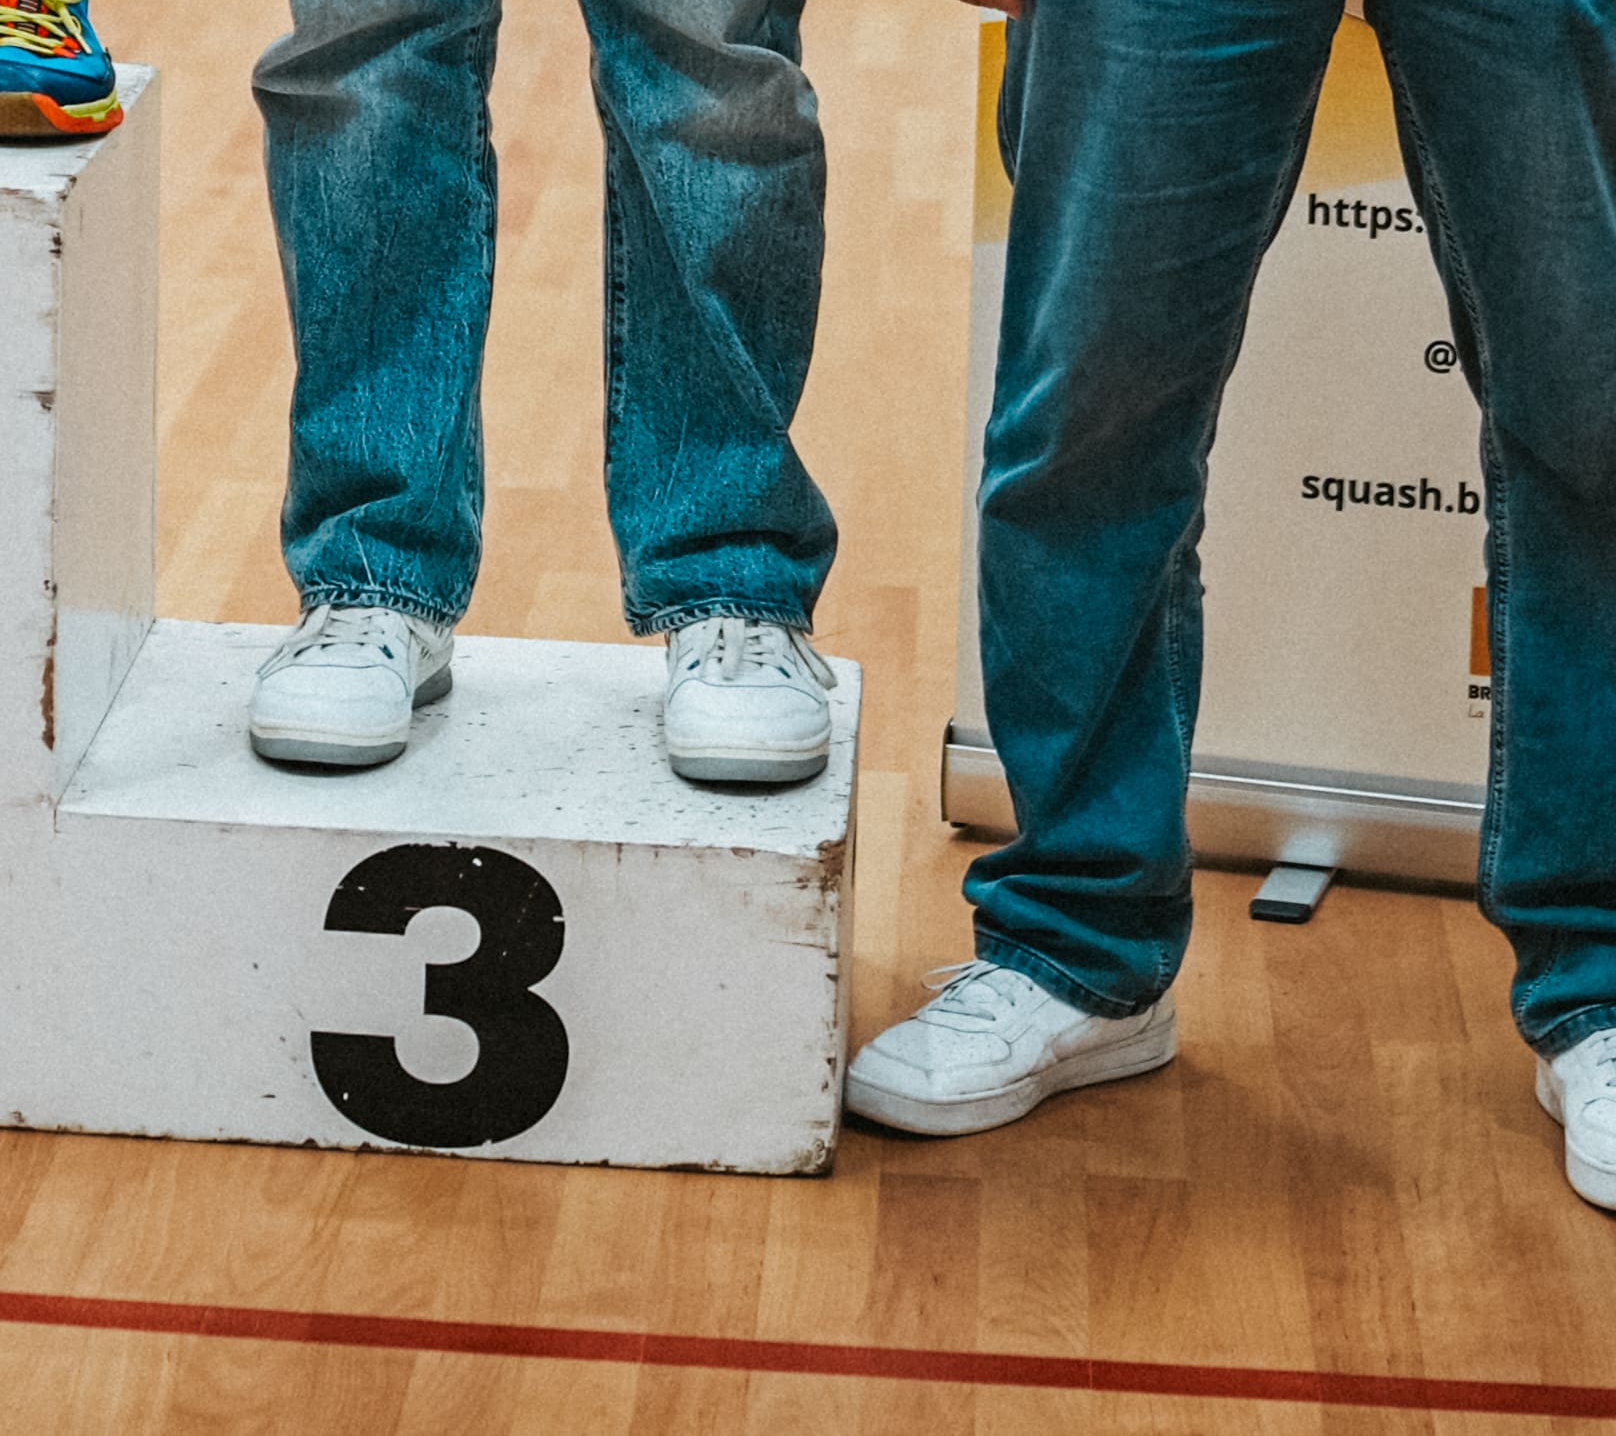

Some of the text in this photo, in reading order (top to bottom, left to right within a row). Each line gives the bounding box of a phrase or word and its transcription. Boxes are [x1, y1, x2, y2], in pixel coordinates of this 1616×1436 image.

[1307, 193, 1424, 240] https:
[1301, 474, 1481, 516] squash.b
[1468, 684, 1492, 701] BR
[309, 843, 570, 1149] 3
